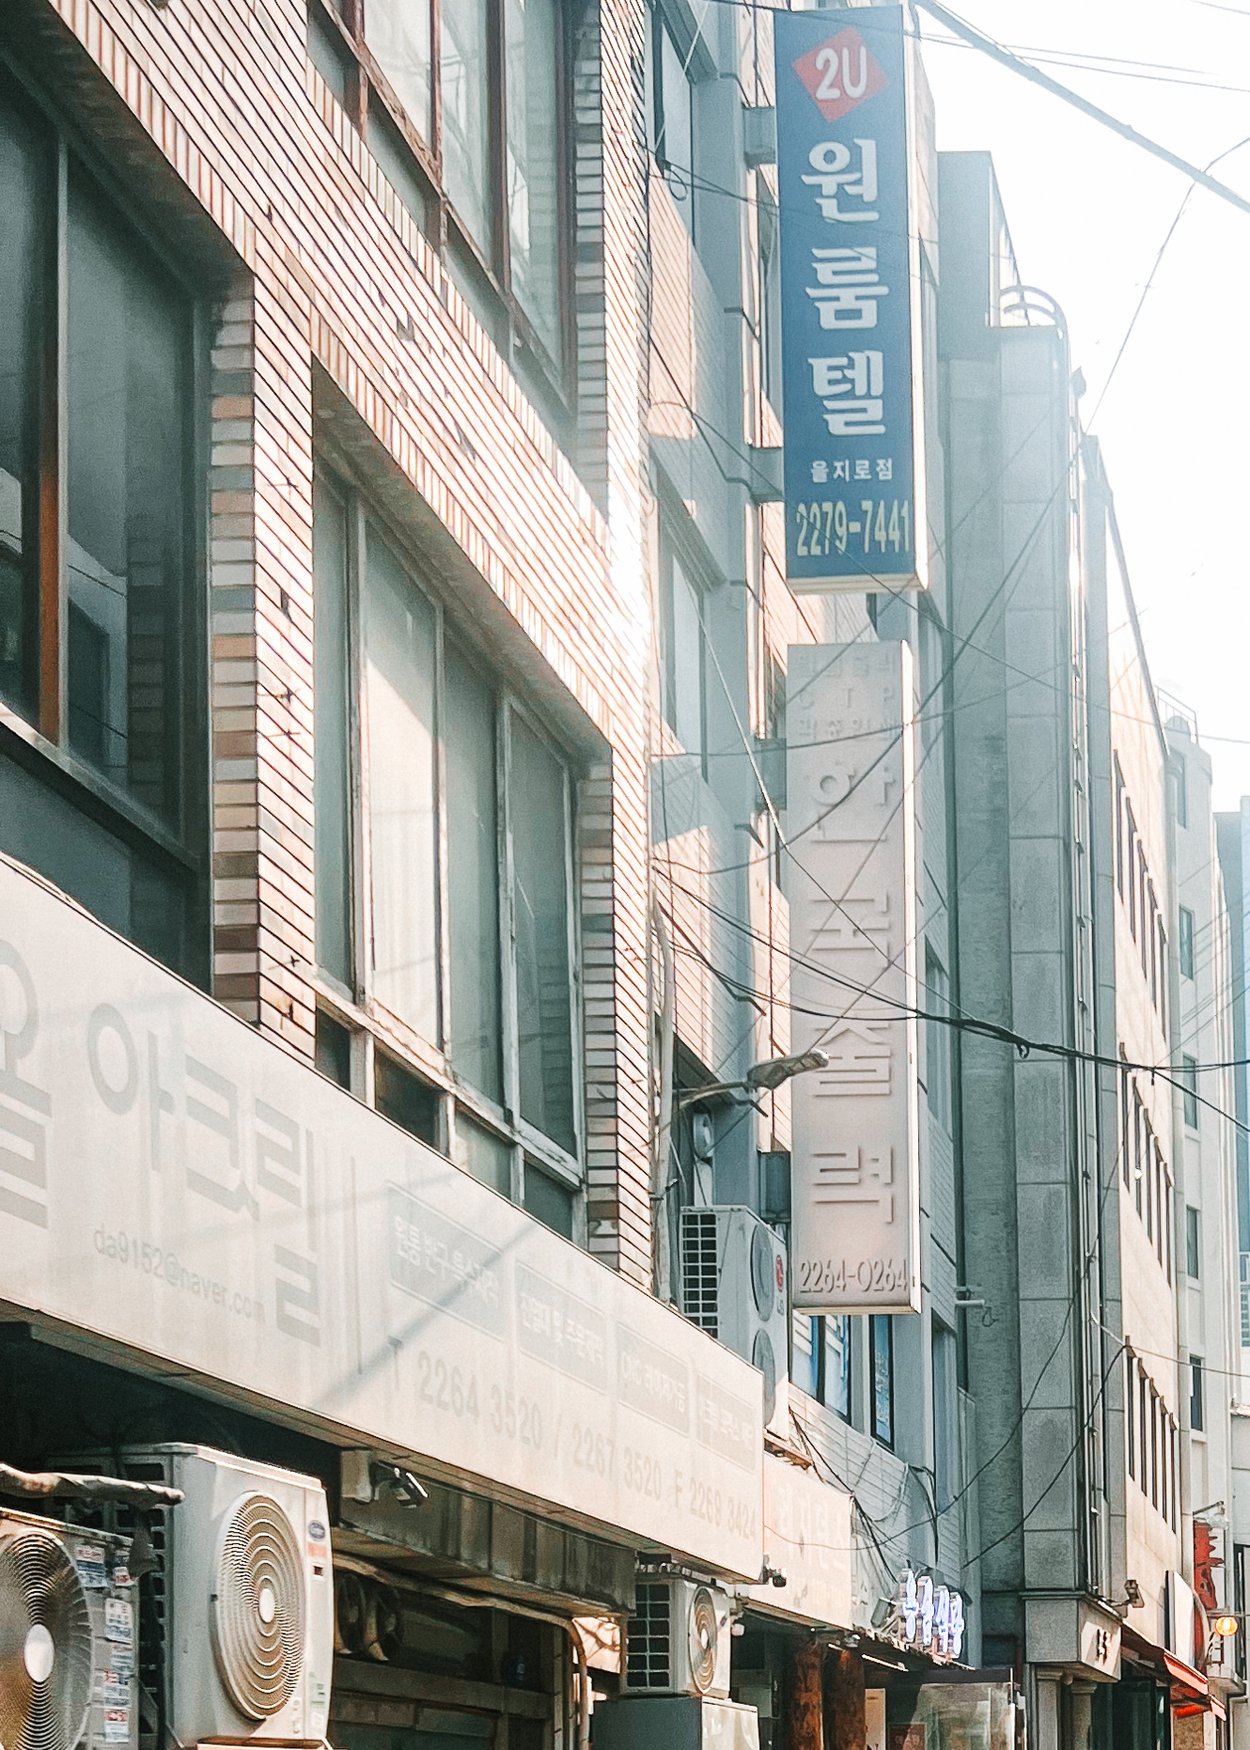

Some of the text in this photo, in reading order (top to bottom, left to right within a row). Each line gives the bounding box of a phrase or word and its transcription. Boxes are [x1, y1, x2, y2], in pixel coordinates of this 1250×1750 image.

[815, 46, 867, 100] 2U
[801, 137, 889, 437] 원룸텔
[810, 456, 894, 484] 을지로점
[796, 499, 911, 557] 2279-7441
[798, 1258, 909, 1294] 2264-0264
[418, 1350, 481, 1426] 2264
